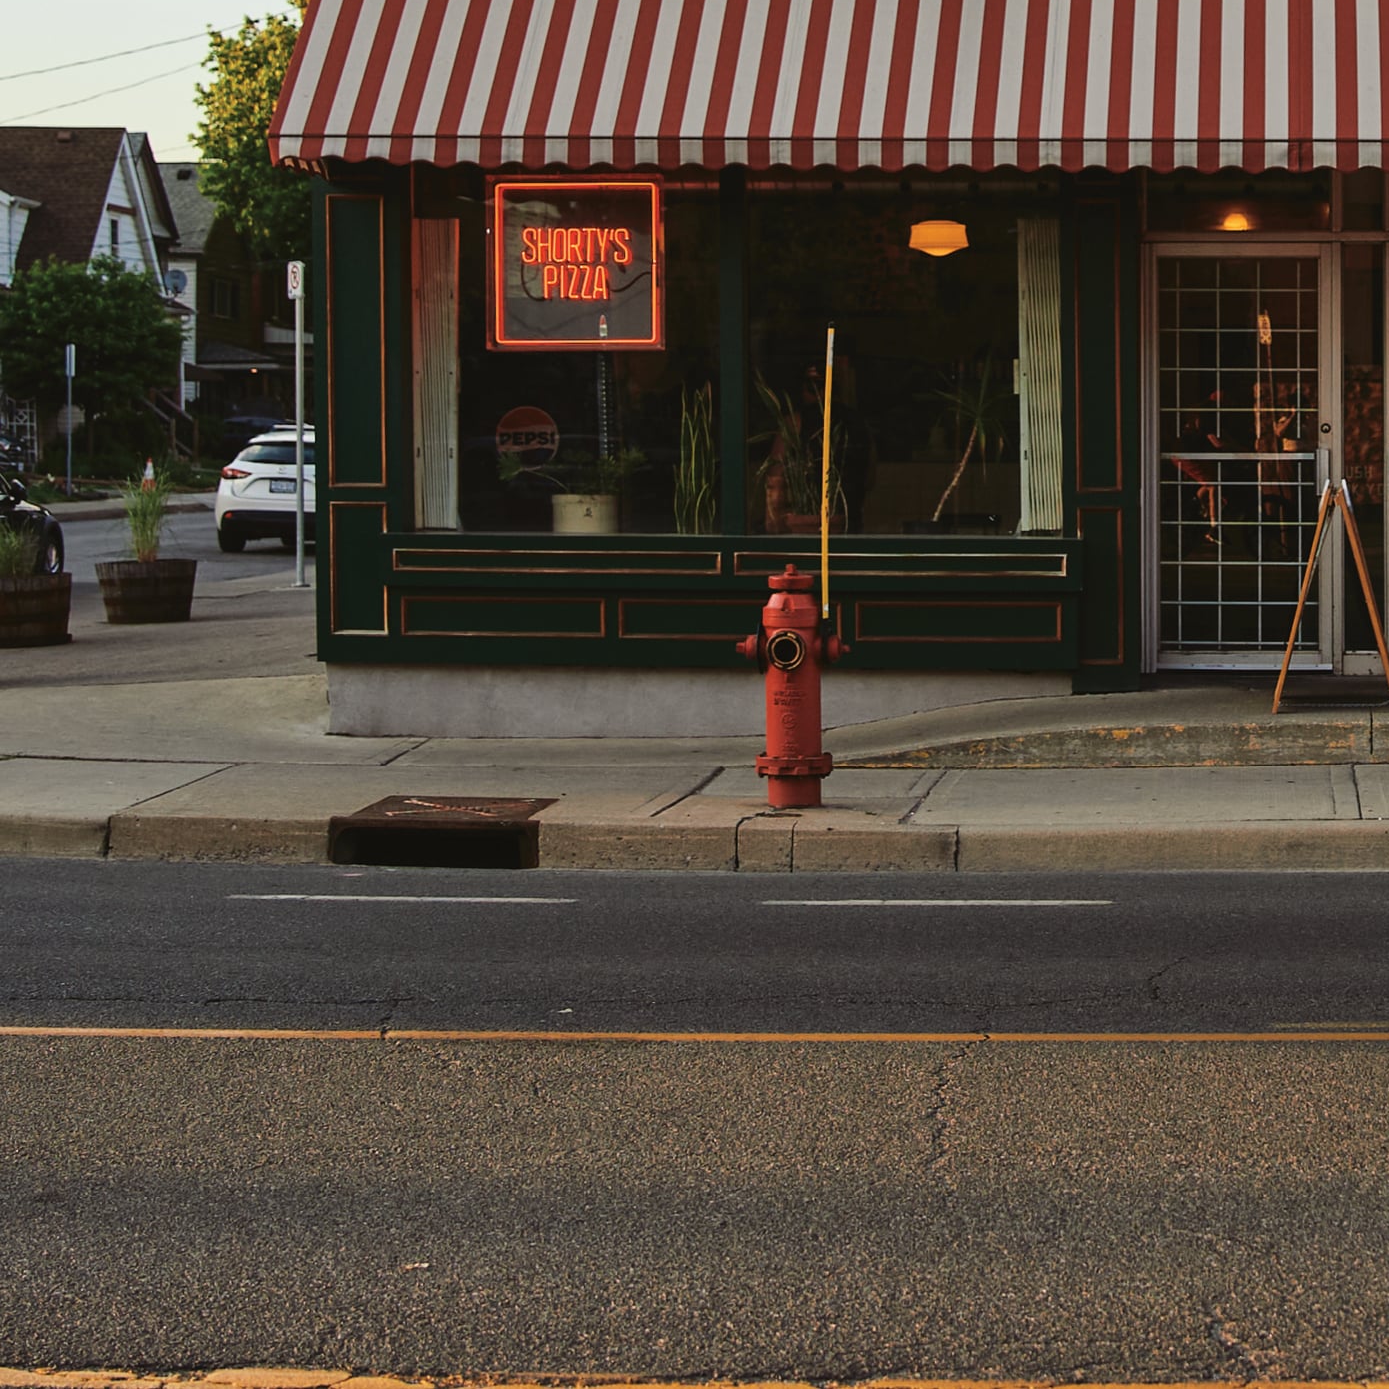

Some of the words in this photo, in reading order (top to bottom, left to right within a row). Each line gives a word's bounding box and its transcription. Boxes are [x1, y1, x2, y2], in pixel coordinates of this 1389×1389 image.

[522, 228, 630, 263] SHORTY'S
[543, 265, 609, 300] PIZZA
[500, 432, 556, 446] PEPSI
